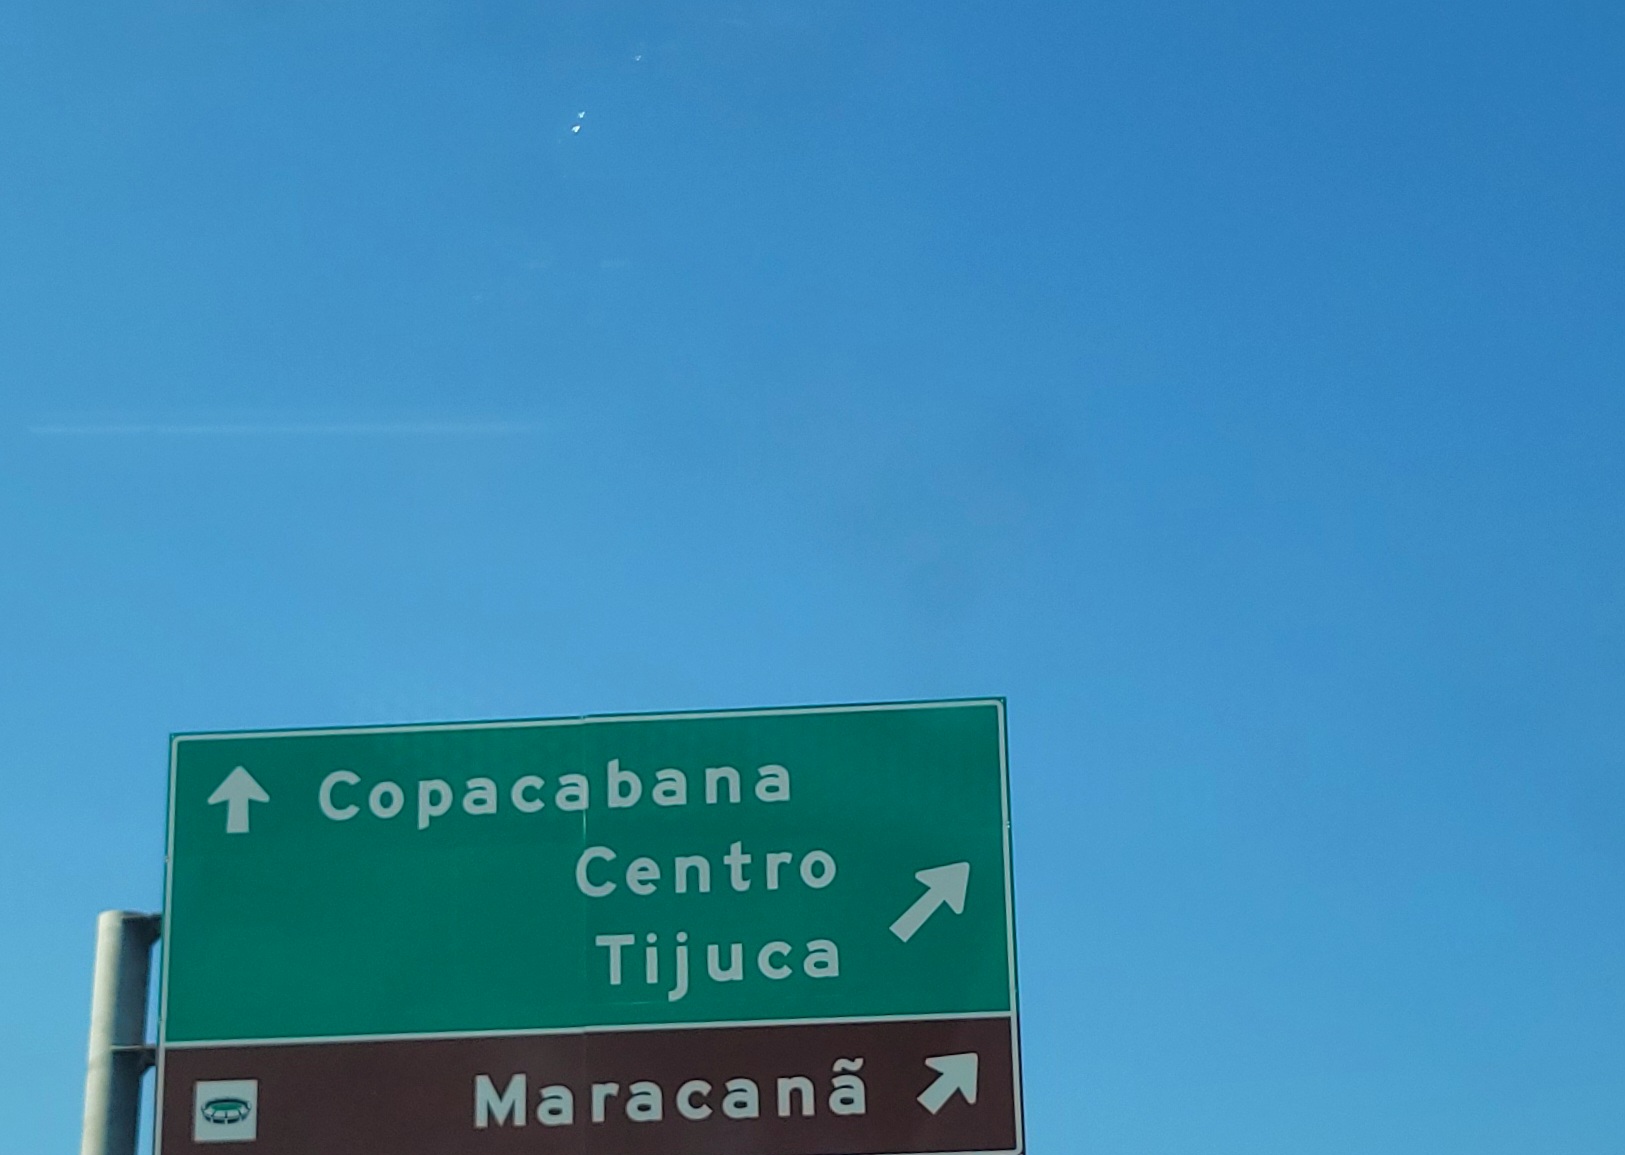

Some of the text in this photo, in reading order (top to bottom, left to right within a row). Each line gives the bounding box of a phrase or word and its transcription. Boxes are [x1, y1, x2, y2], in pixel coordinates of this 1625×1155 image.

[319, 758, 790, 829] Copacabana
[575, 841, 836, 897] Centro
[596, 931, 839, 1001] Tijuca
[474, 1058, 866, 1128] Maracanã
